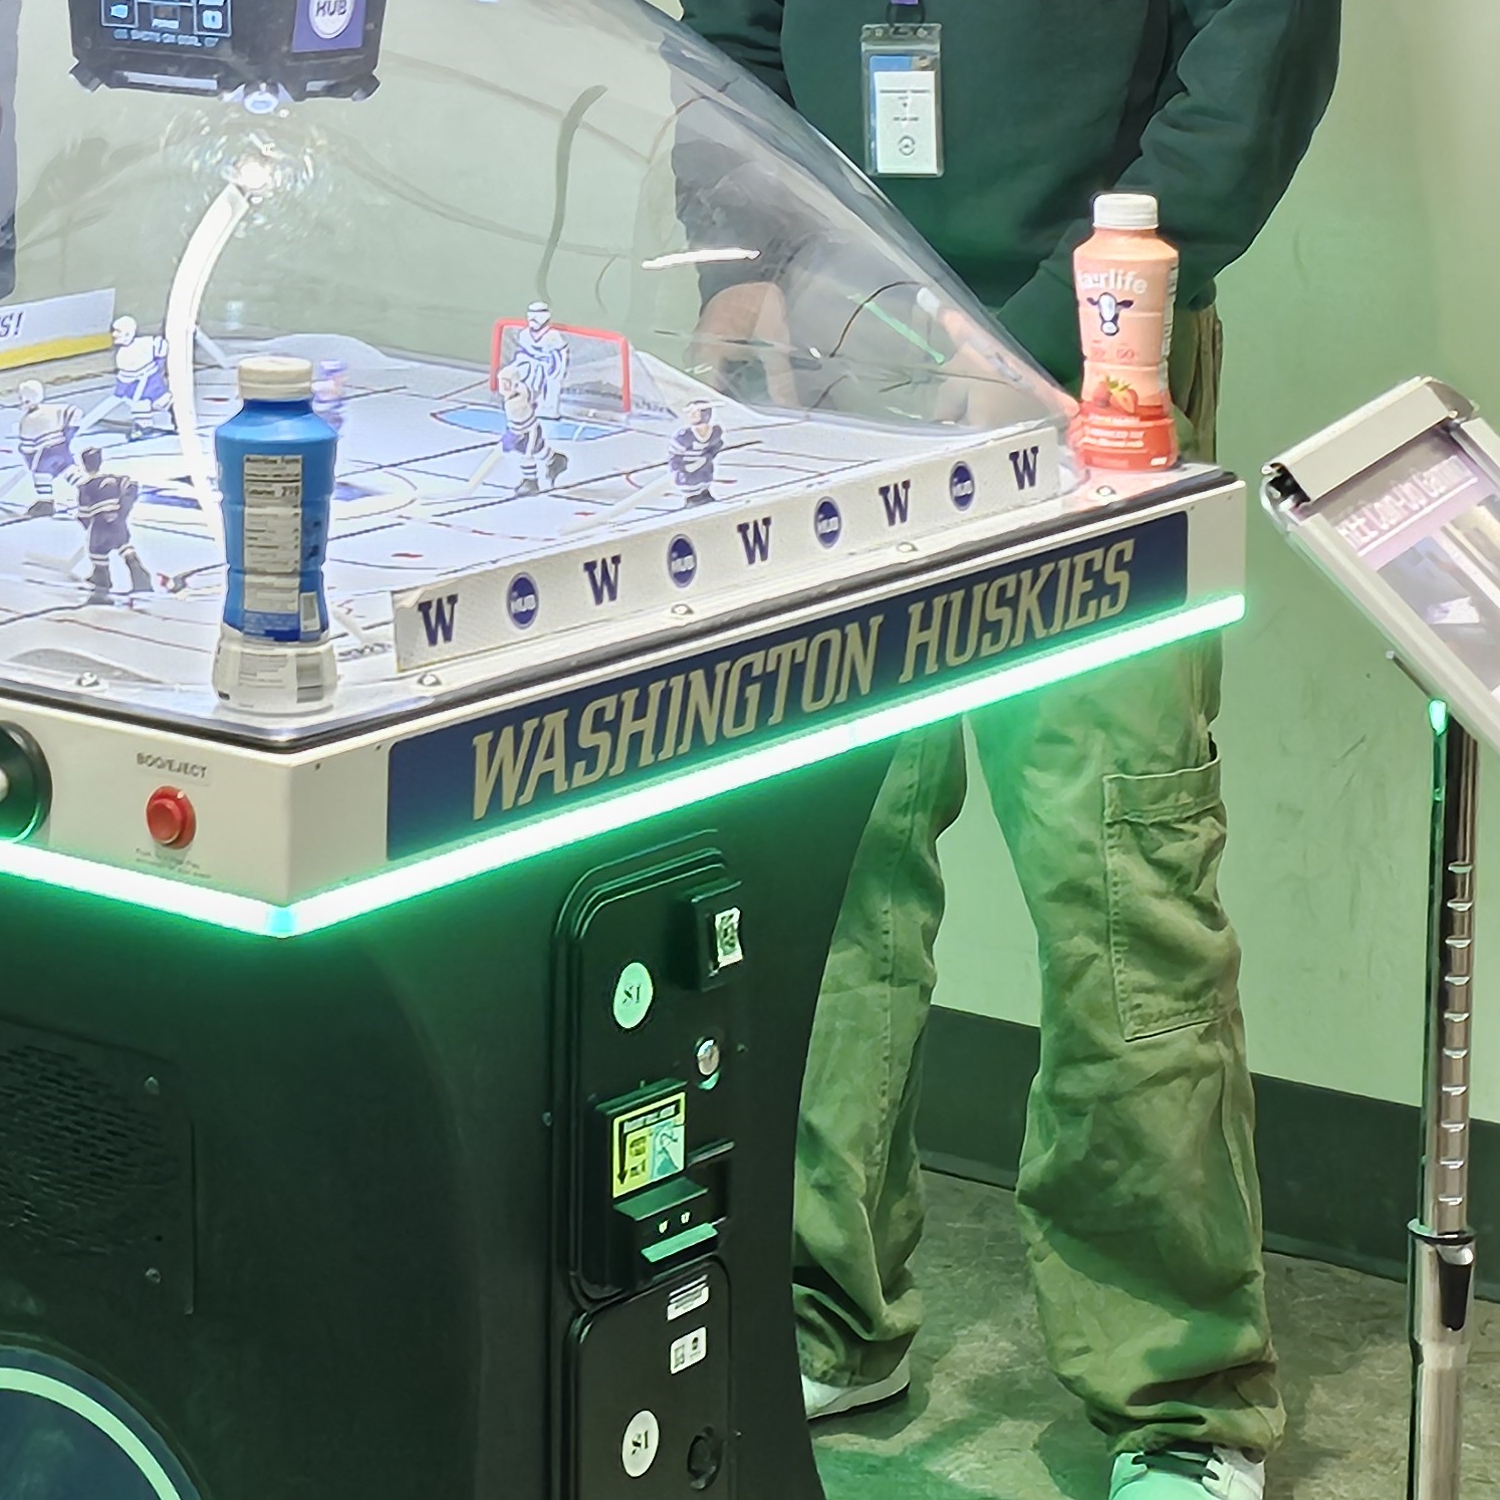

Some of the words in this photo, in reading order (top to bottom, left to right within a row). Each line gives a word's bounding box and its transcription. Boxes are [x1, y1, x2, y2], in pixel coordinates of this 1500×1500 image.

[316, 0, 347, 17] HUB
[417, 594, 458, 647] W
[583, 554, 622, 606] W
[736, 516, 772, 565] W
[878, 479, 911, 527] W
[1008, 446, 1039, 490] W
[471, 613, 885, 821] WASHINGTON
[898, 539, 1135, 683] HUSKIES
